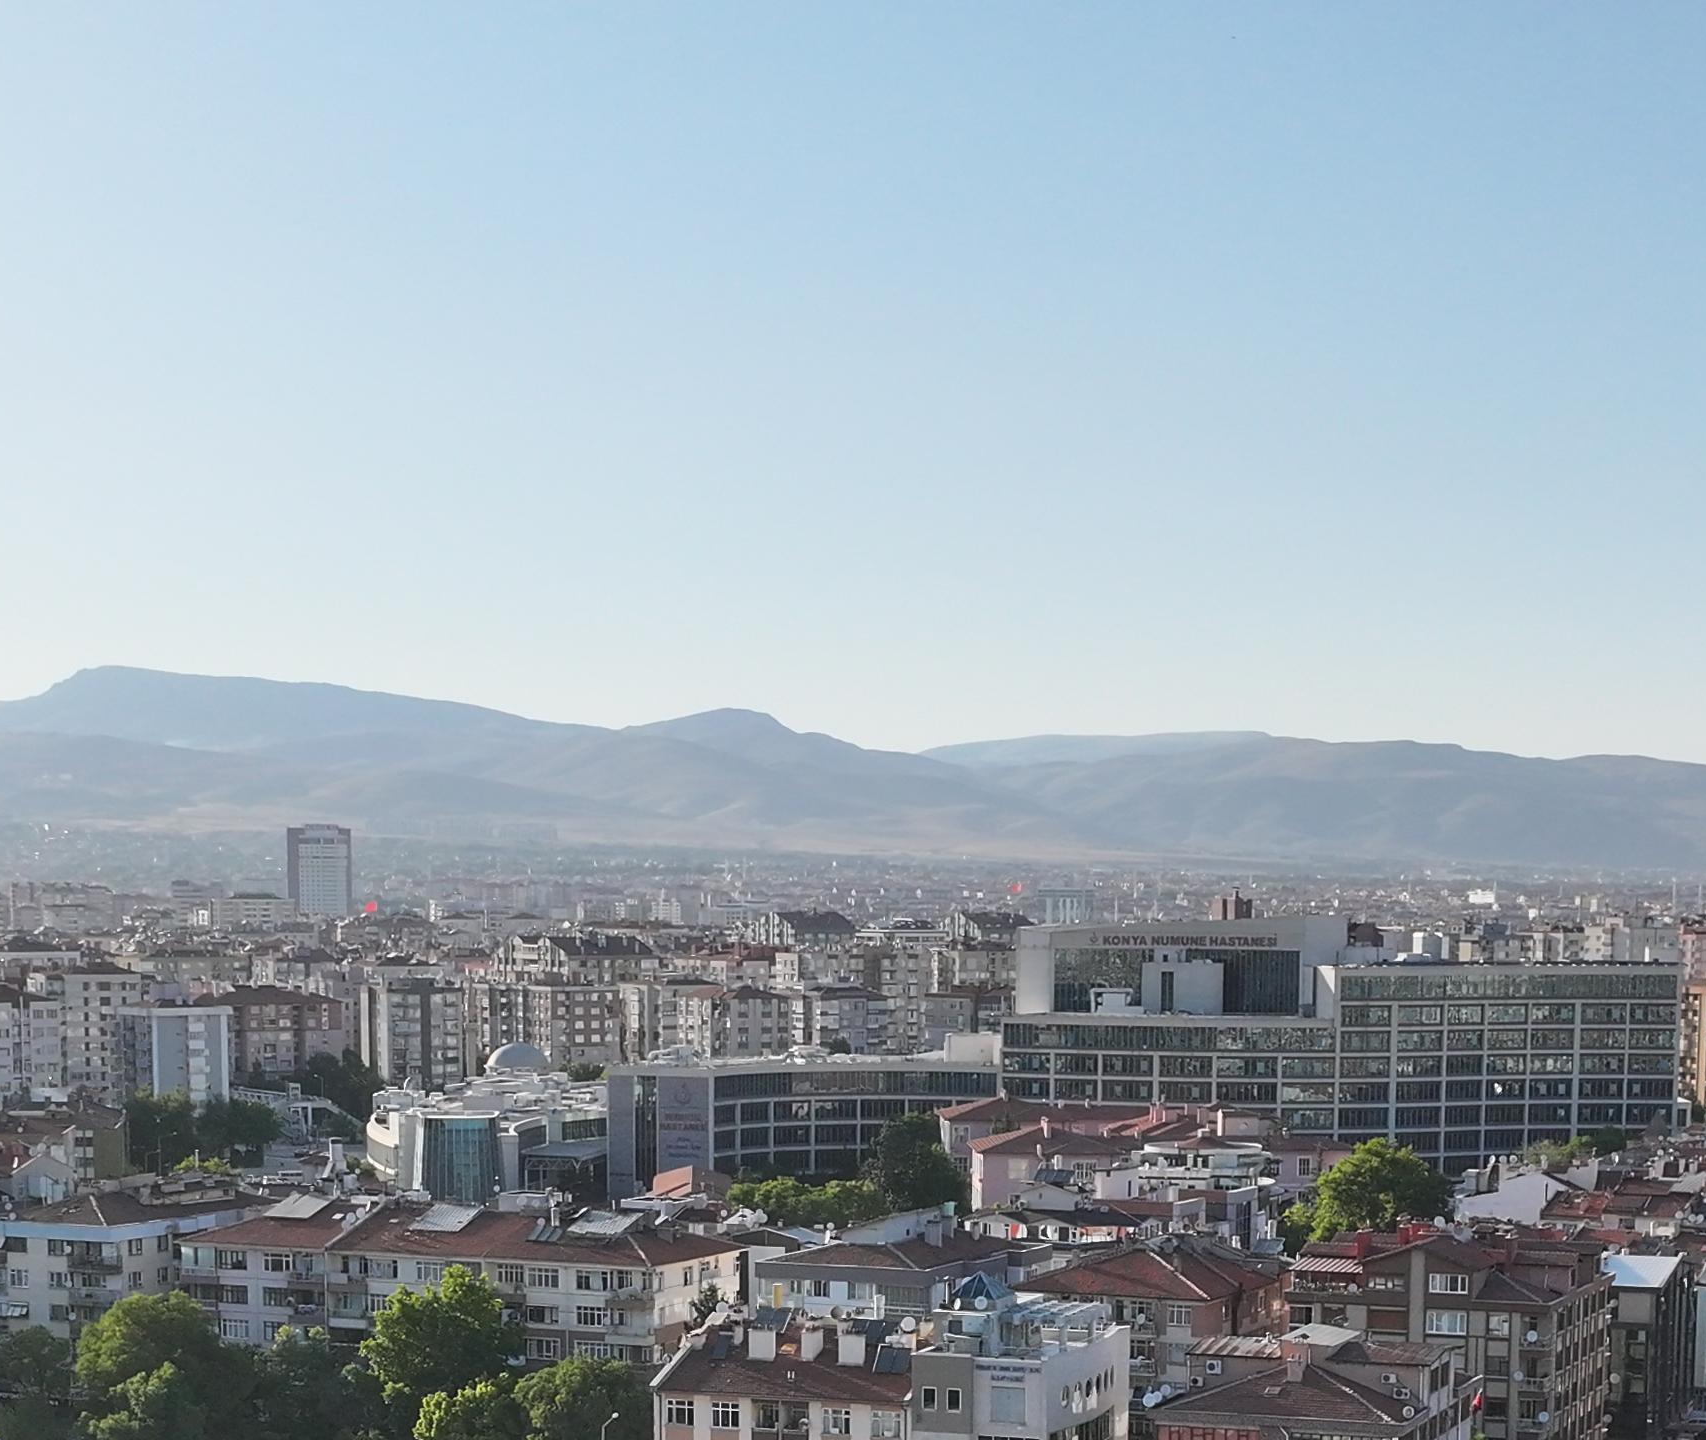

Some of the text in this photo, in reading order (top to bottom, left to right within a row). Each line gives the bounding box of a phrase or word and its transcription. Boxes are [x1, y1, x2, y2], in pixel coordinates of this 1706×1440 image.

[1102, 932, 1278, 948] KONYA NUMUNE HASTANESİ
